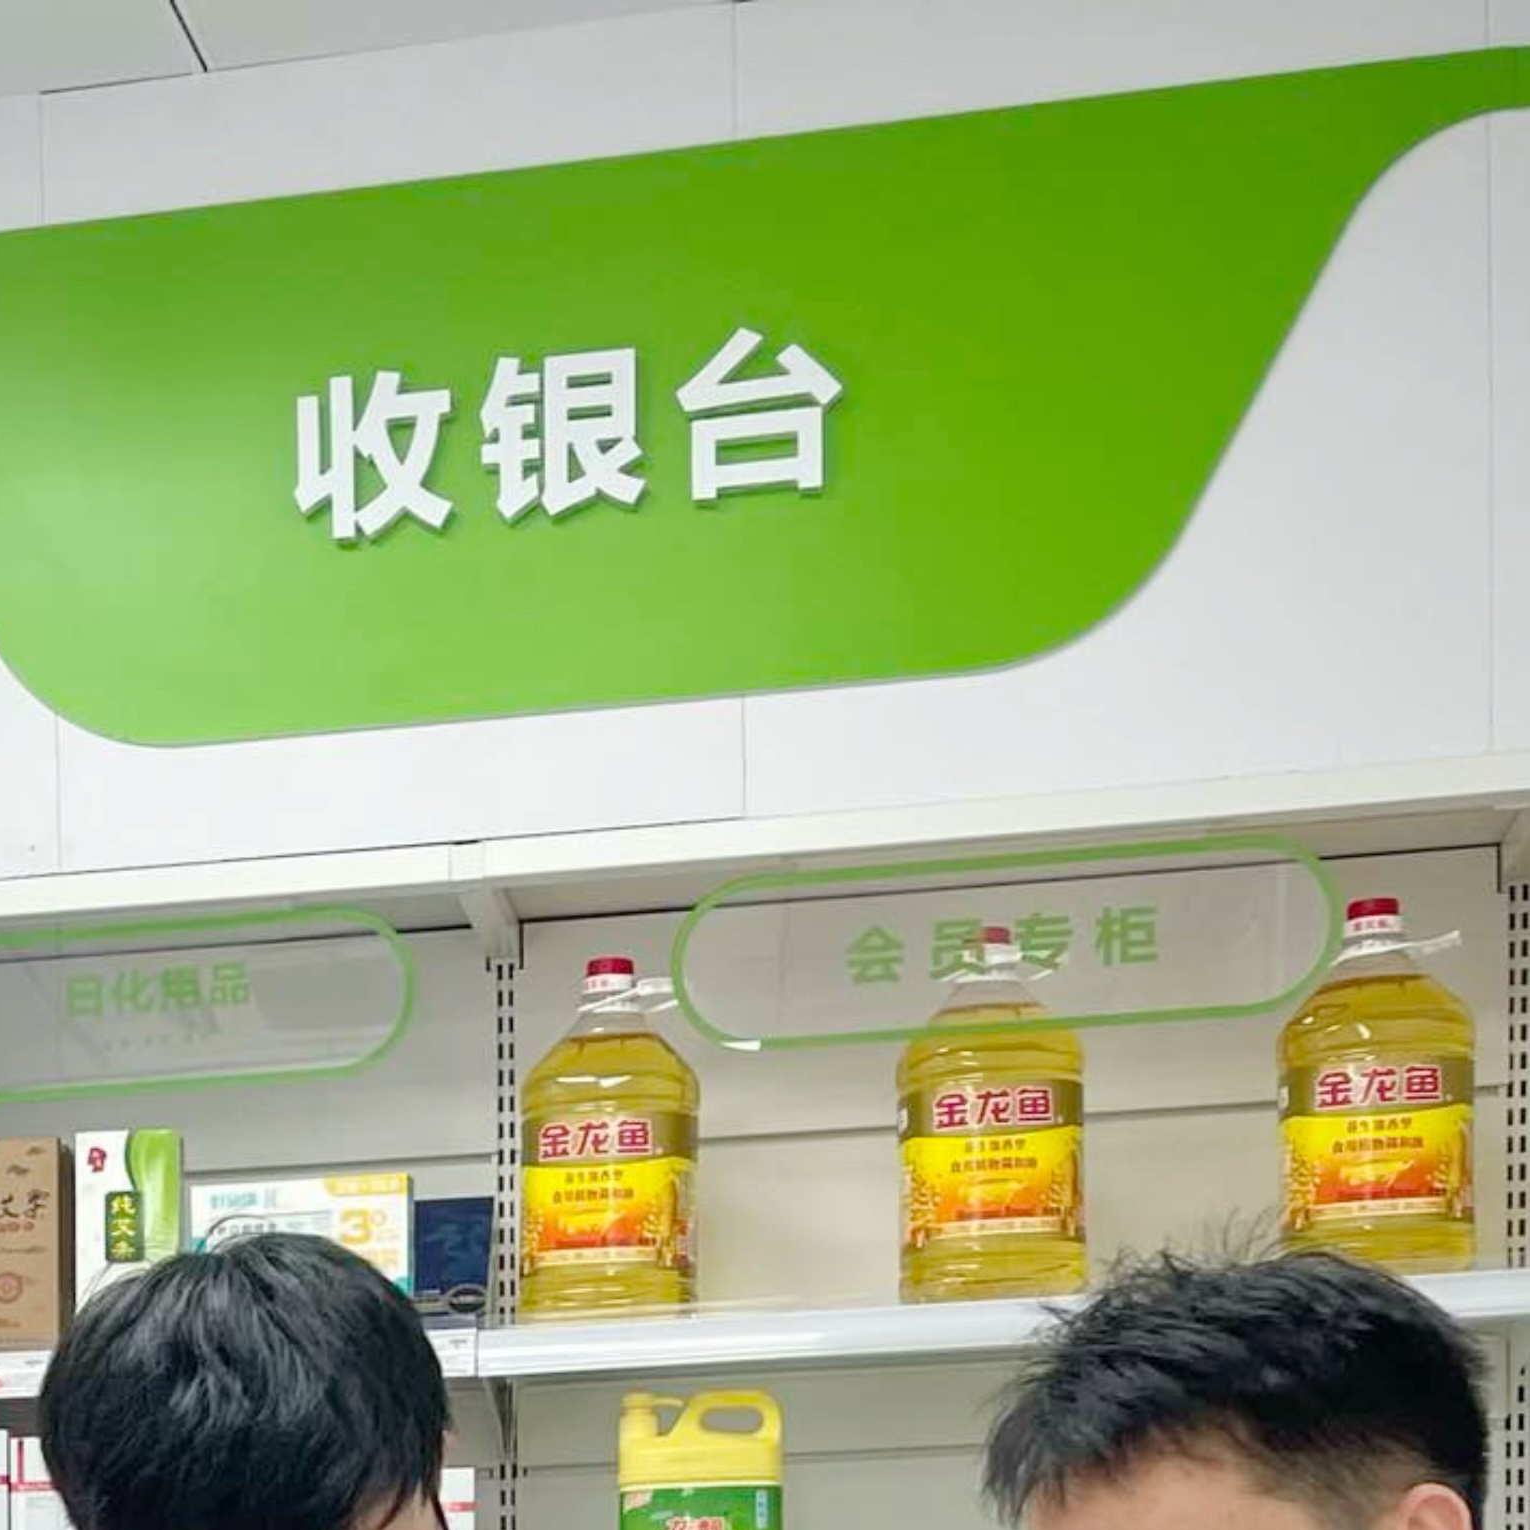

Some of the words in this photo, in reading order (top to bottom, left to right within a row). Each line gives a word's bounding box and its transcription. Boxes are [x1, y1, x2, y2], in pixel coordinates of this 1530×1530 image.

[292, 325, 844, 542] 收银台
[846, 903, 1160, 986] 会员专柜
[66, 960, 253, 1021] 日化用品
[933, 1087, 1053, 1129] 金龙鱼
[1316, 1065, 1441, 1109] 金龙鱼
[540, 1120, 651, 1159] 金龙鱼
